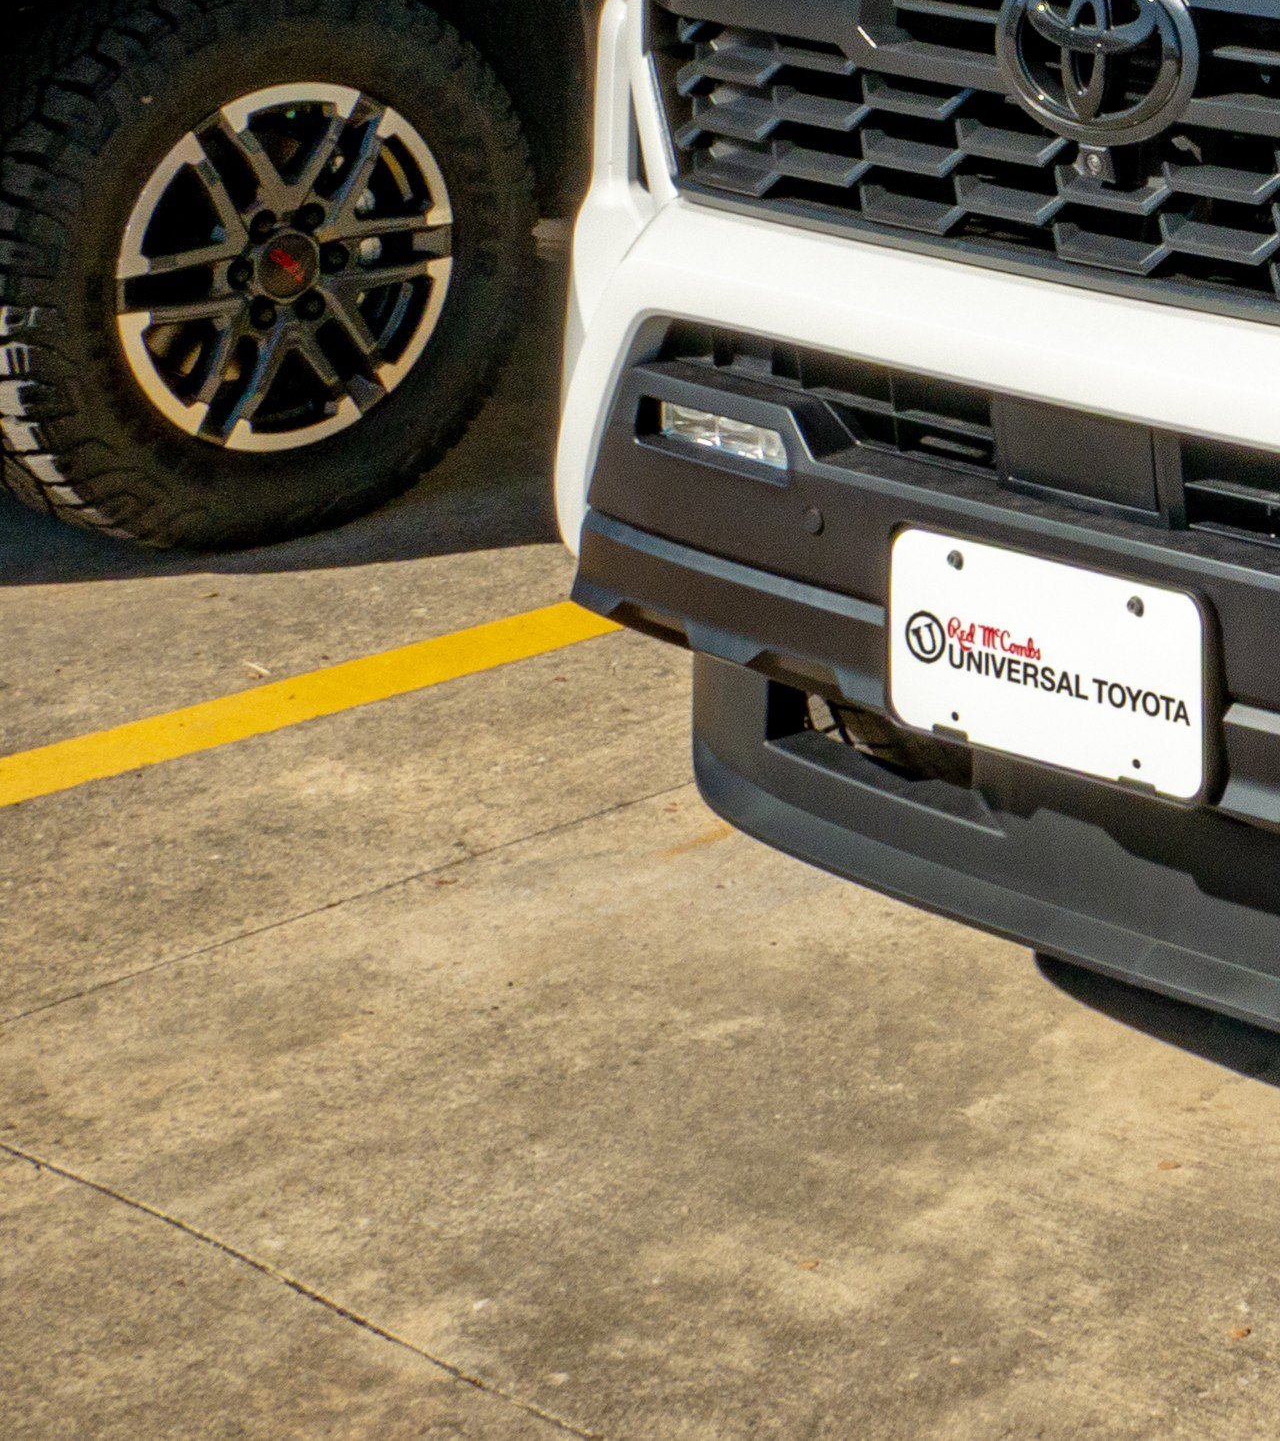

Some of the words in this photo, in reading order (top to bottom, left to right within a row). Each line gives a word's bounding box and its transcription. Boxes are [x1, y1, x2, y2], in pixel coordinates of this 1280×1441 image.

[947, 617, 976, 651] Red
[949, 644, 1089, 700] UNIVERSAL
[1092, 678, 1191, 726] TOYOTA
